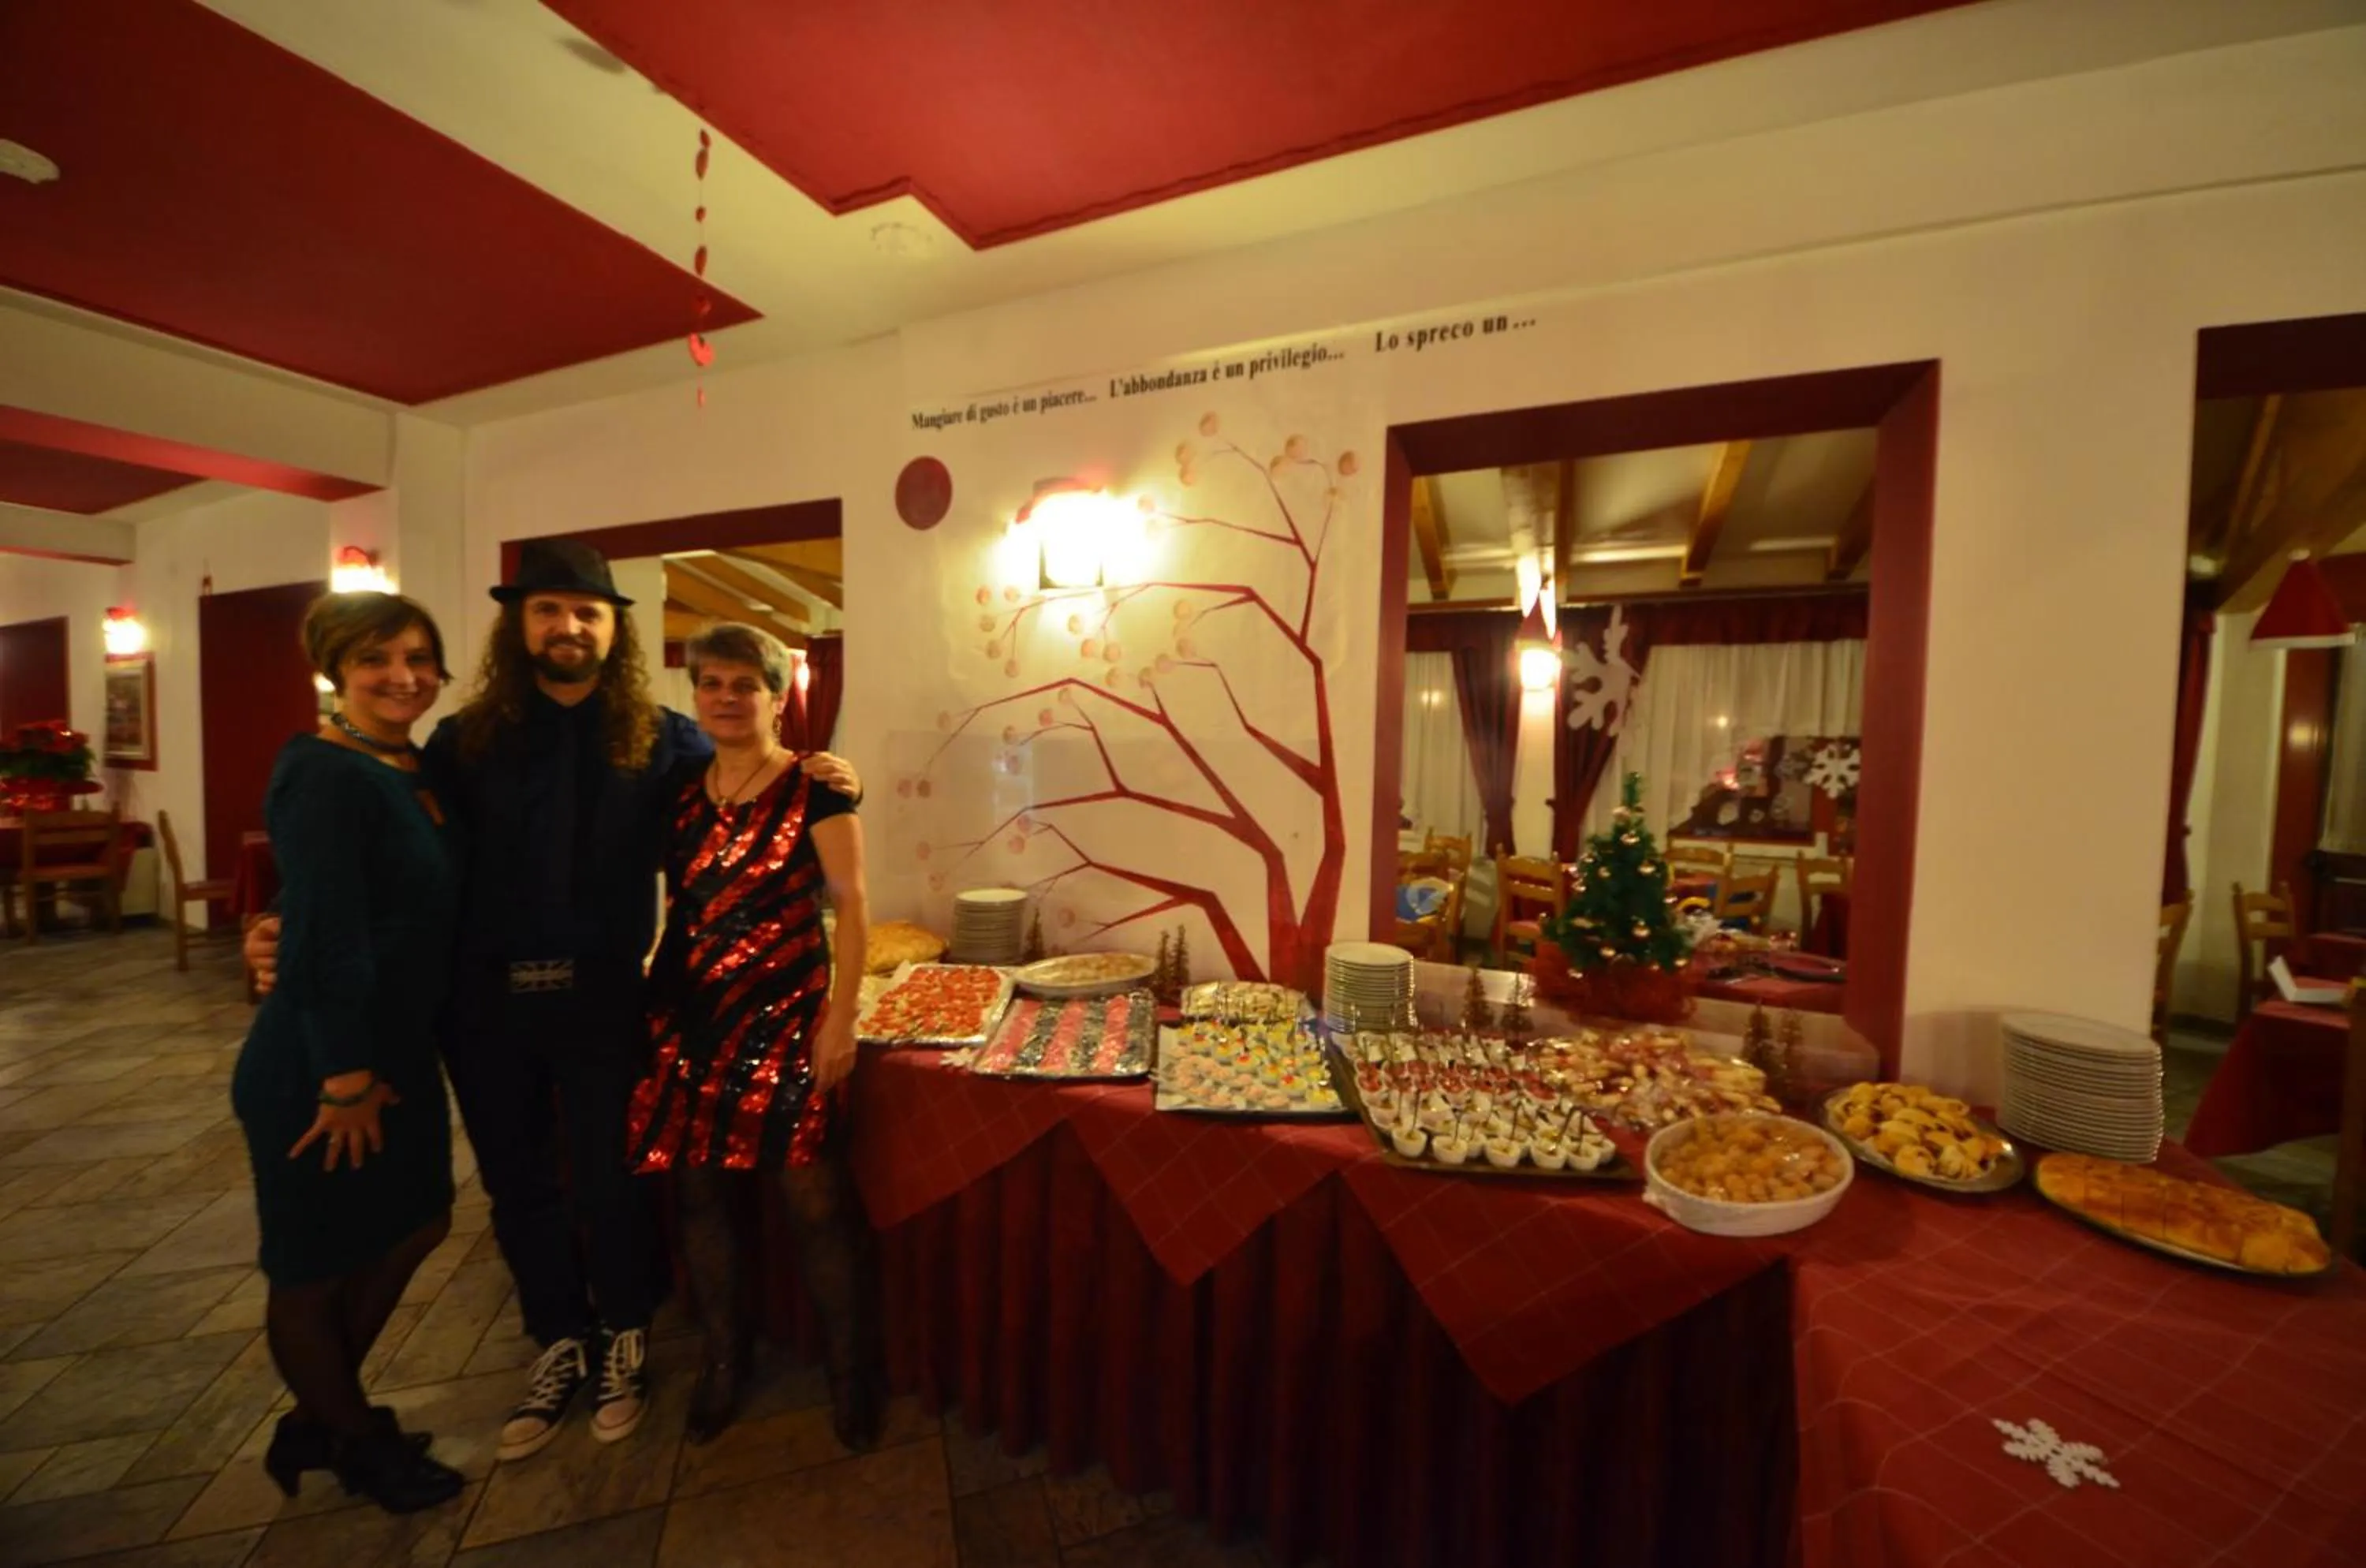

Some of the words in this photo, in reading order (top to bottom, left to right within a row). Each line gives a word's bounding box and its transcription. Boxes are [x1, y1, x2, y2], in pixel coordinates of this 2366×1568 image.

[1375, 331, 1398, 353] Lo
[1407, 321, 1474, 352] spreco
[1110, 368, 1207, 398] L'abbondanza
[1226, 362, 1244, 378] un
[1249, 343, 1345, 380] privilegio...
[912, 409, 963, 431] Mangiare
[966, 403, 977, 422] di
[980, 402, 1009, 423] gusto
[1022, 398, 1037, 413] un
